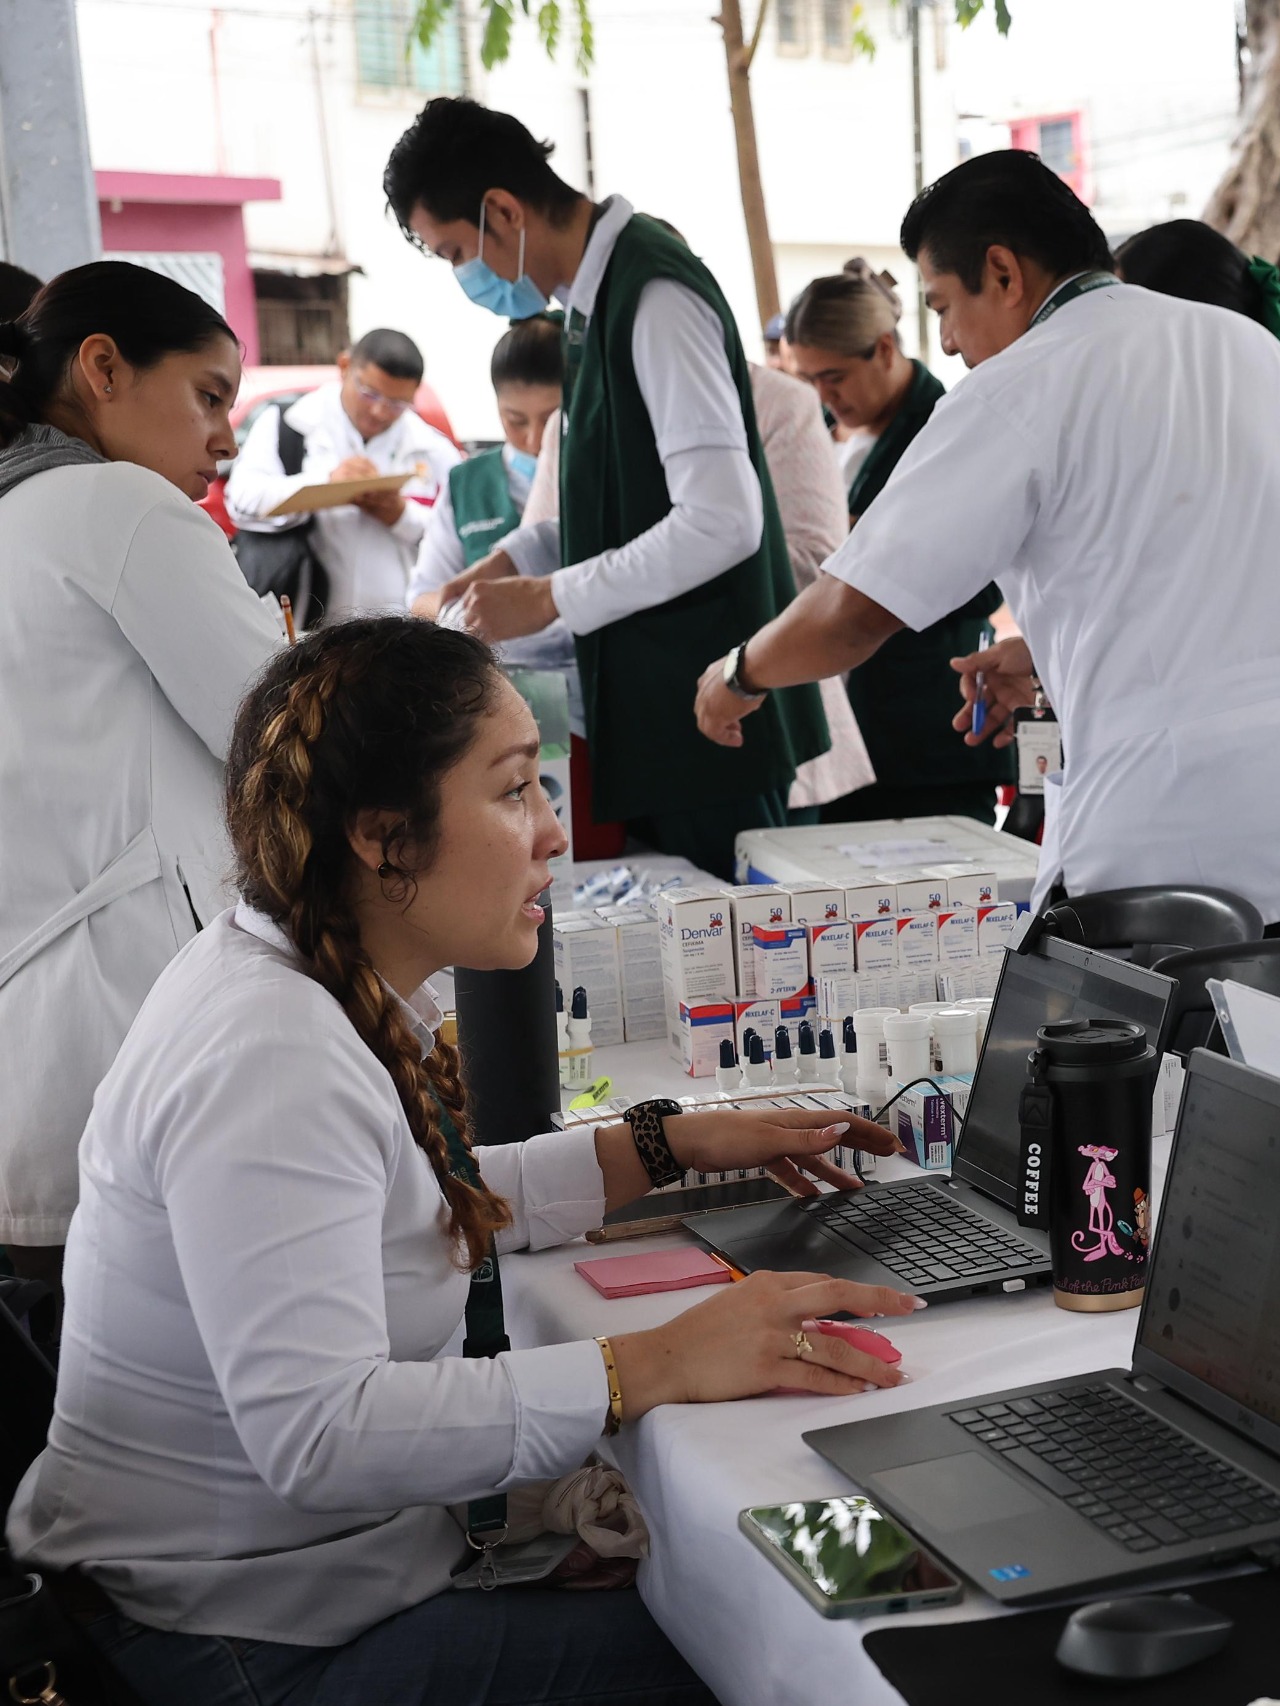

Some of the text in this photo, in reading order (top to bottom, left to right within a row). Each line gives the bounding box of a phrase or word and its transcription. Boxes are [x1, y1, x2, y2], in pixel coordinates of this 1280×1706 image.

[986, 914, 1014, 923] NIXELAF-C
[909, 921, 934, 930] NIXELAF-C
[681, 926, 724, 941] Denvar
[820, 932, 850, 941] NIXELAF-C
[865, 928, 894, 938] NIXELAF-C
[745, 1008, 775, 1018] NIXELAF-C
[1024, 1143, 1042, 1215] COFFEE
[1068, 1279, 1080, 1293] of
[1081, 1280, 1100, 1293] the
[1100, 1277, 1129, 1293] Pink
